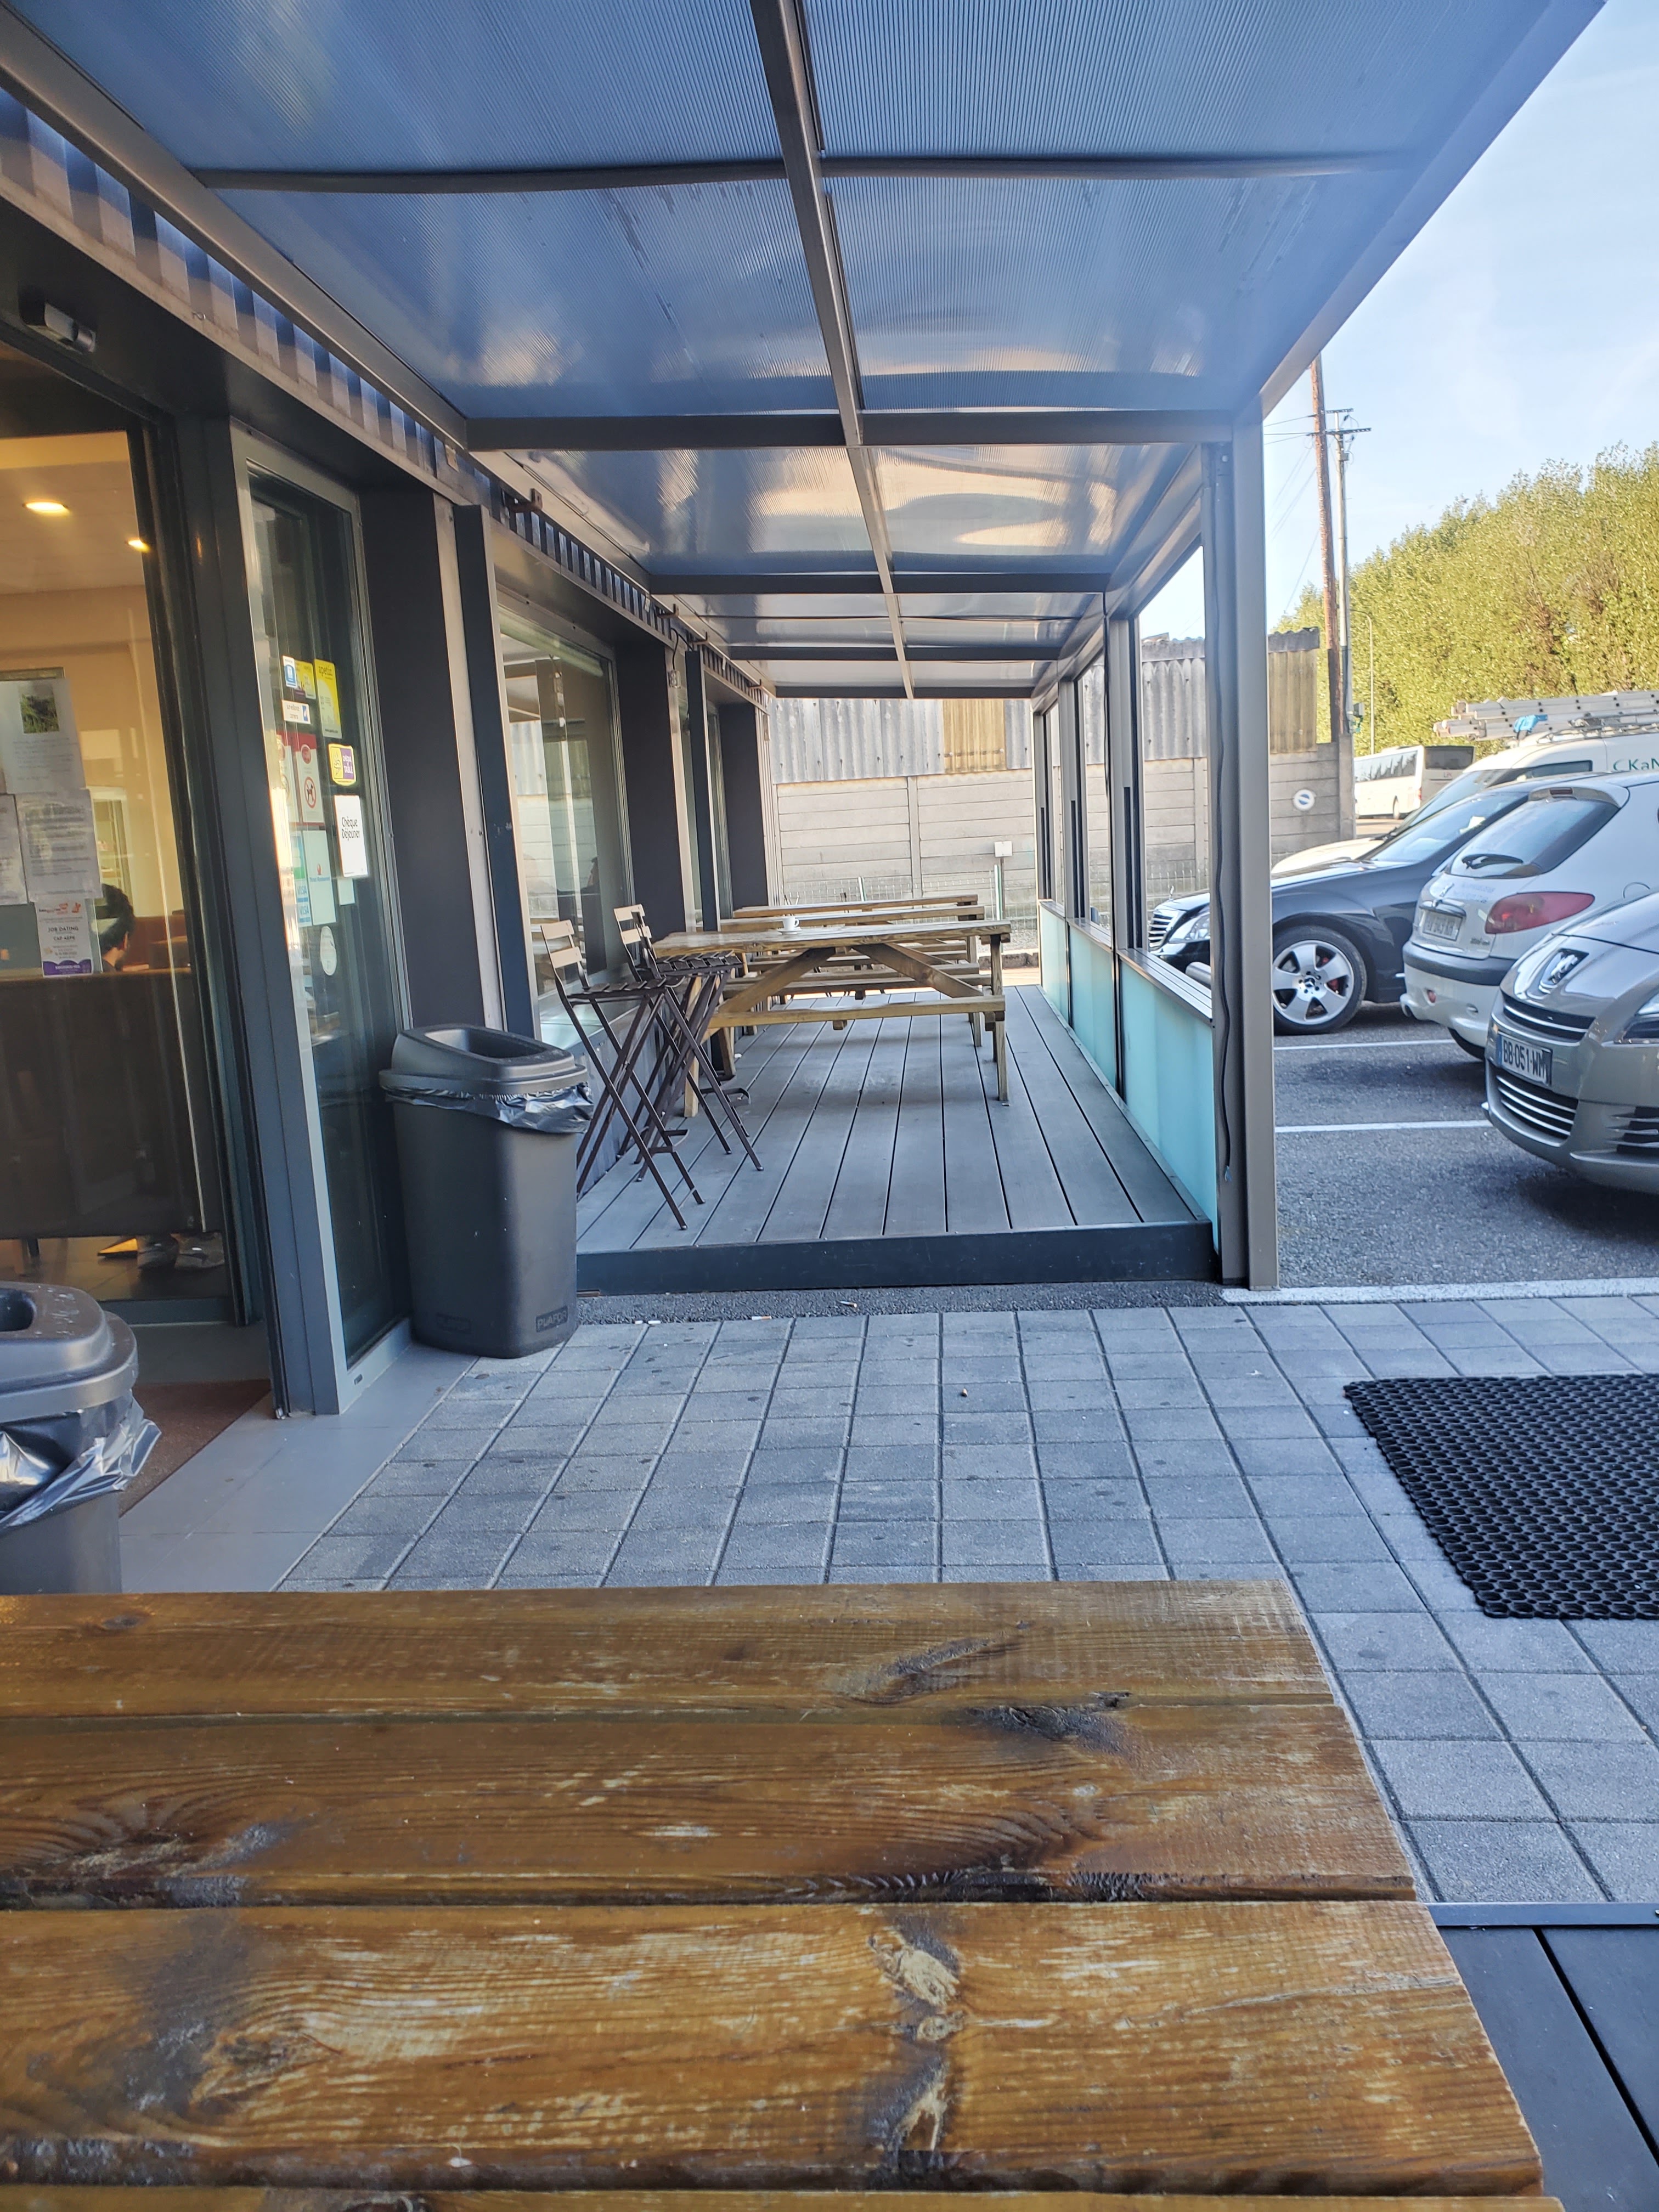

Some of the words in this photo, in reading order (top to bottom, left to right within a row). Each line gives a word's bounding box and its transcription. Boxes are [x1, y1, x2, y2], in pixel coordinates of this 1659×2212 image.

[341, 816, 358, 829] Chèque
[341, 828, 360, 841] Déjeuner
[297, 885, 307, 895] VISA
[300, 905, 309, 915] VISA
